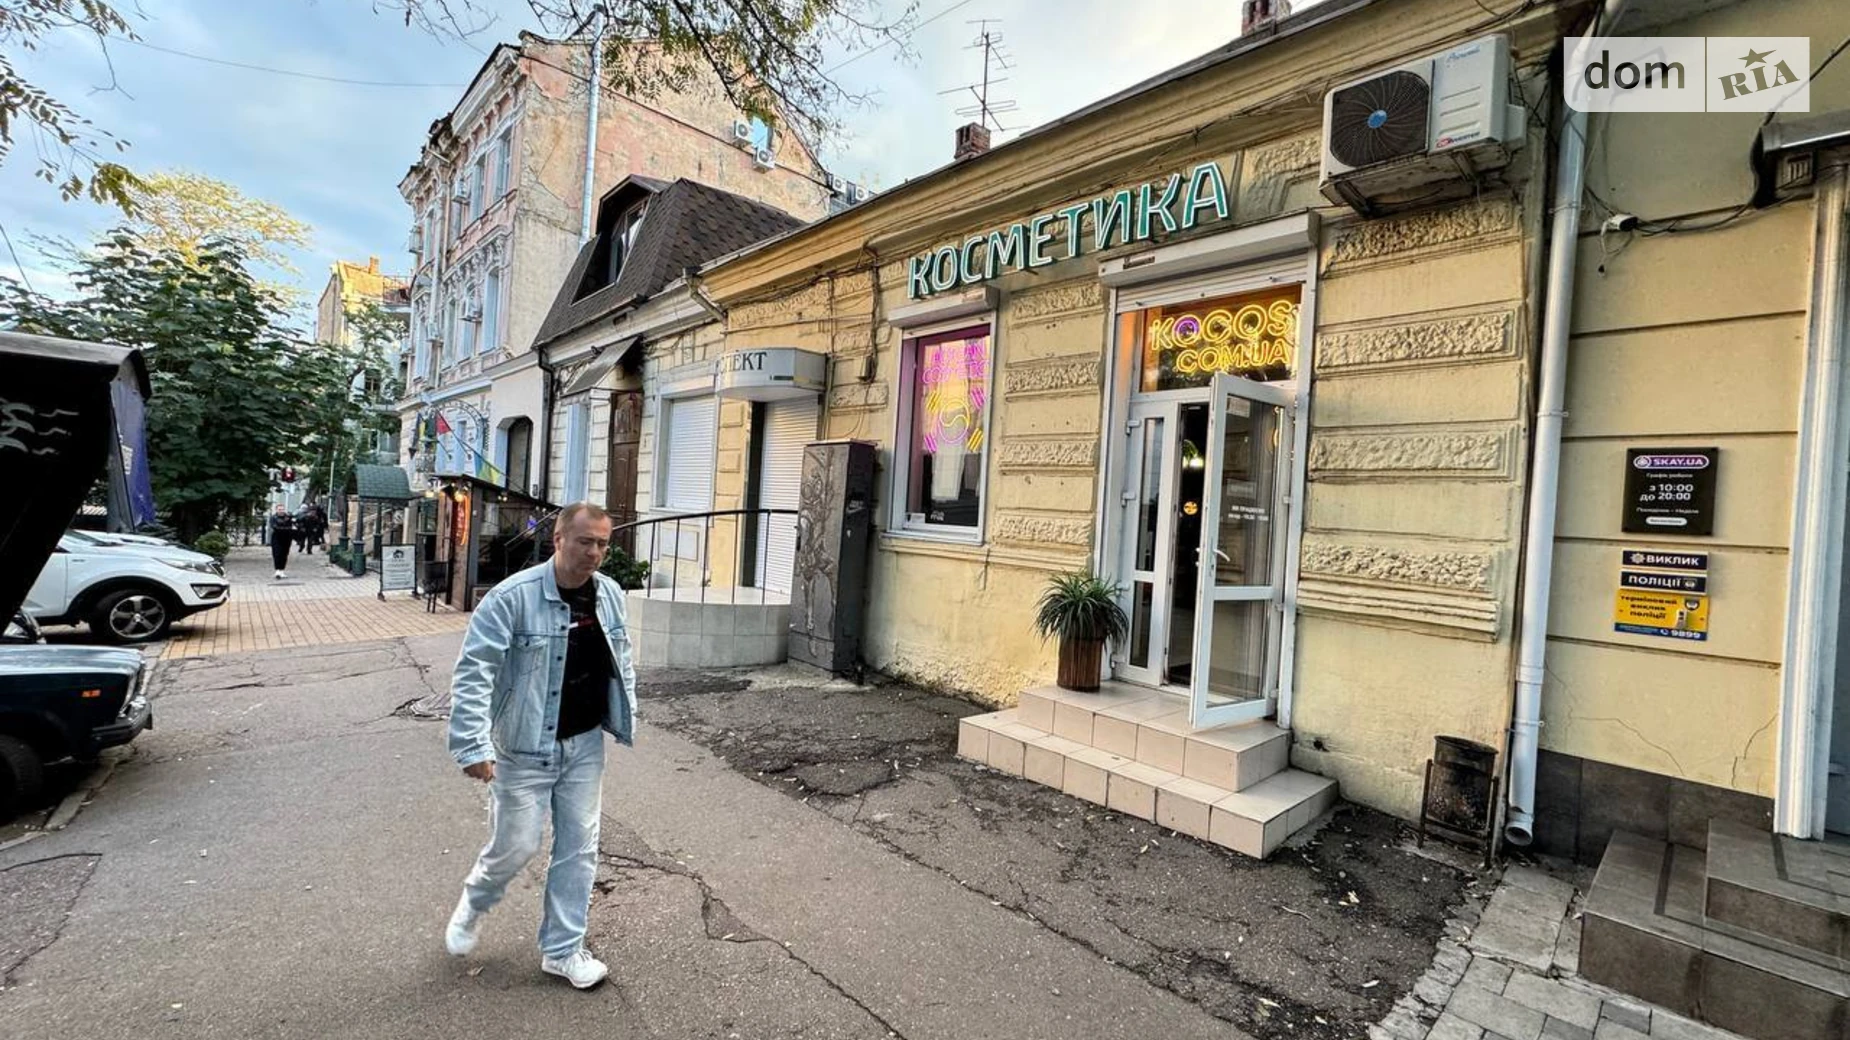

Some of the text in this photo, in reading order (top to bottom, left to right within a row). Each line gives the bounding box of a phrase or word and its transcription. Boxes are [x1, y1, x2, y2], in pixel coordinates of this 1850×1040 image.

[907, 161, 1229, 299] КОСМЕТИКА
[1152, 300, 1293, 350] KOCOS
[1176, 338, 1291, 373] COM.UA
[1653, 458, 1704, 466] SKAY.UA
[1659, 484, 1694, 492] 10:00
[1640, 492, 1691, 502] до 20:00
[1646, 555, 1699, 566] ВИКЛИК
[1628, 575, 1681, 587] ПОЛІЦІЇ
